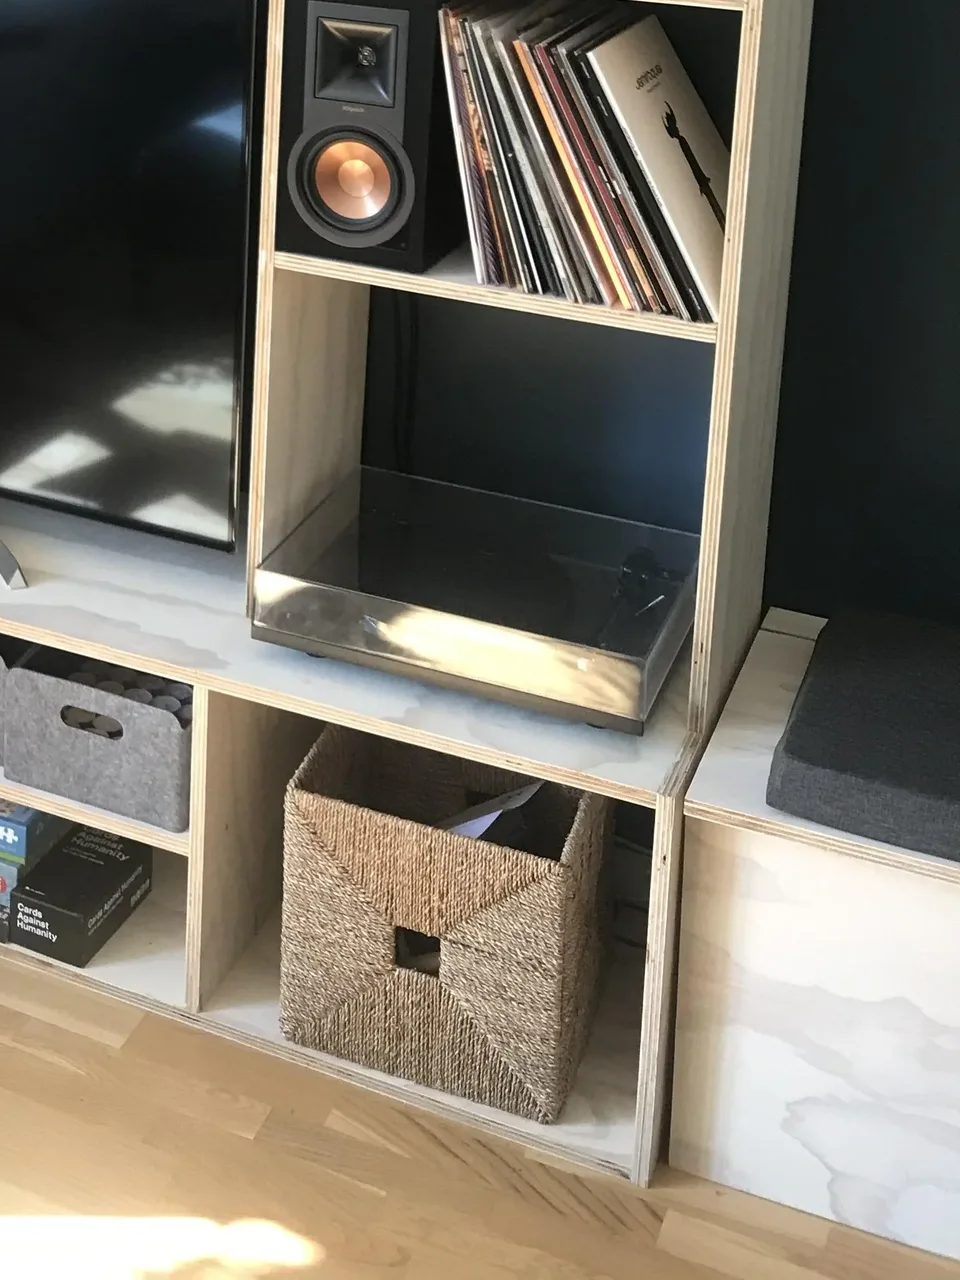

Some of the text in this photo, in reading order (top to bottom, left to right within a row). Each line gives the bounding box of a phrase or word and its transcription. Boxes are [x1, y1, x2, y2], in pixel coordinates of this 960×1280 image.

[72, 837, 130, 861] Humanity
[16, 911, 49, 930] Against
[17, 903, 43, 919] Cards
[16, 919, 58, 942] Humanity
